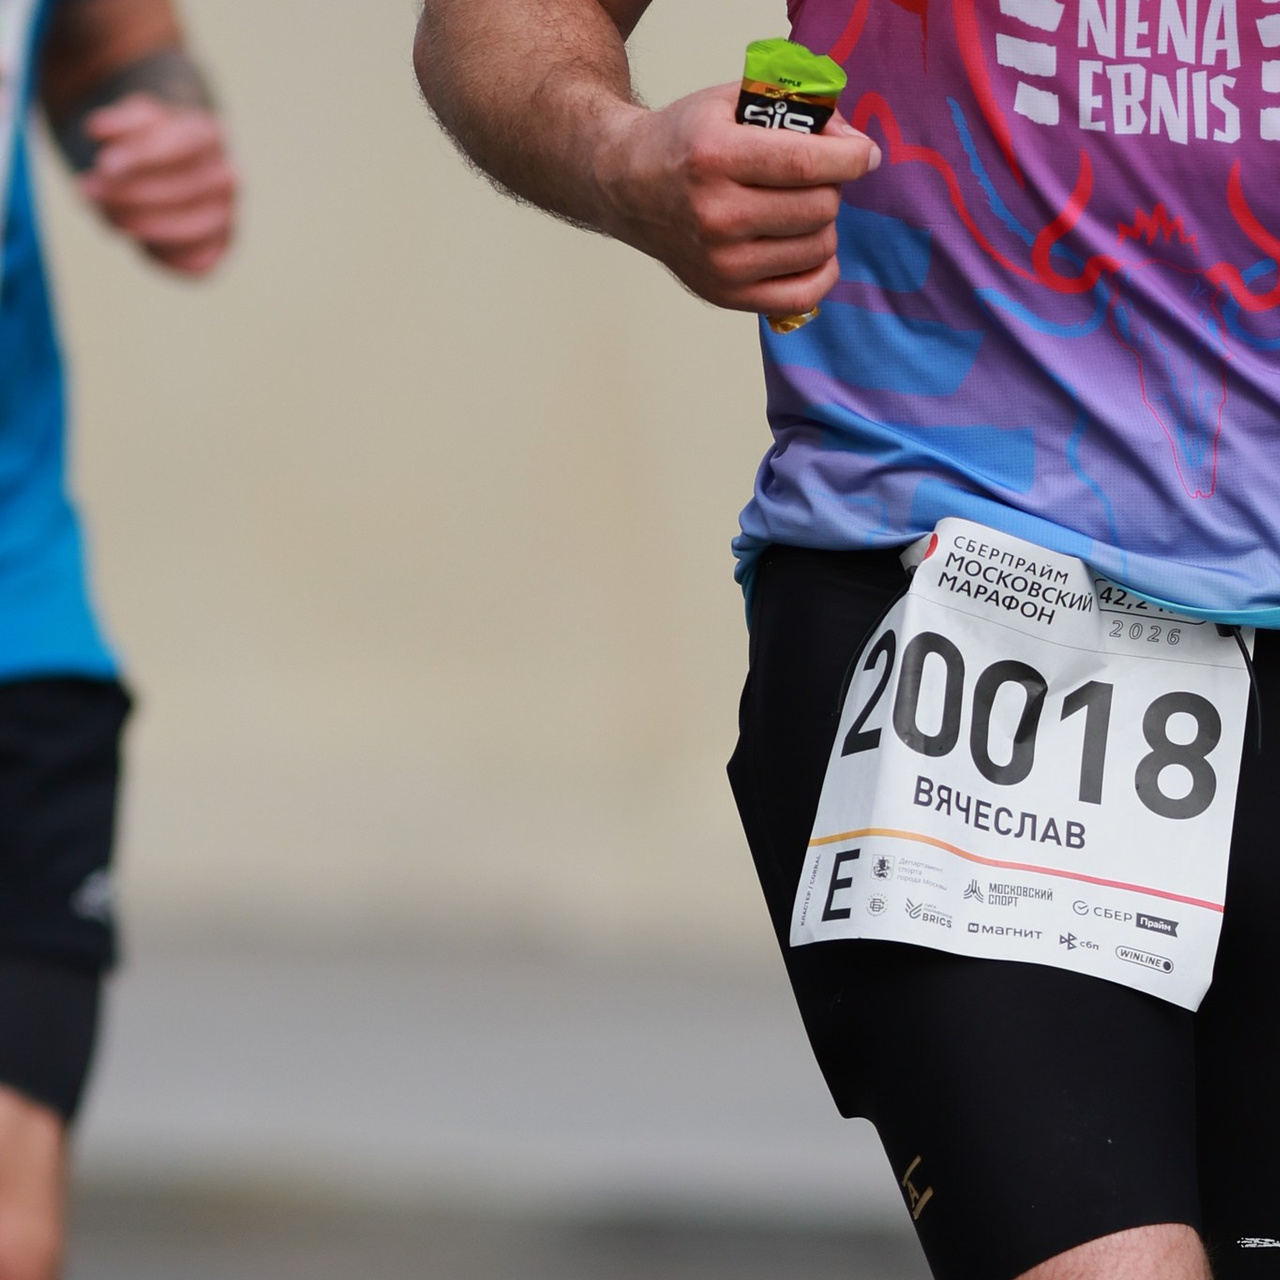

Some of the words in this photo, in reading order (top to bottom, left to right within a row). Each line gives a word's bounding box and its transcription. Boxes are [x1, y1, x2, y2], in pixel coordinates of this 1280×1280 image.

[778, 77, 802, 87] APPLE
[1079, 59, 1241, 145] EBNIS
[954, 536, 1069, 585] СБЕРПРАЙМ
[945, 552, 1093, 612] МОСКОВСКИЙ
[938, 572, 1056, 625] МАРАФОН
[1109, 620, 1181, 645] 2026
[841, 629, 1222, 820] 20018
[914, 775, 1086, 849] ВЯЧЕСЛАВ
[821, 848, 861, 922] E
[988, 882, 1053, 901] МОСКОВСКИЙ
[988, 895, 1019, 907] СПОРТ
[922, 912, 952, 928] BRICS
[982, 924, 1043, 939] магнит
[1093, 906, 1132, 922] СБЕР
[1140, 916, 1171, 932] Прайм
[1080, 940, 1099, 950] сбп
[1120, 949, 1162, 968] WINLINE
